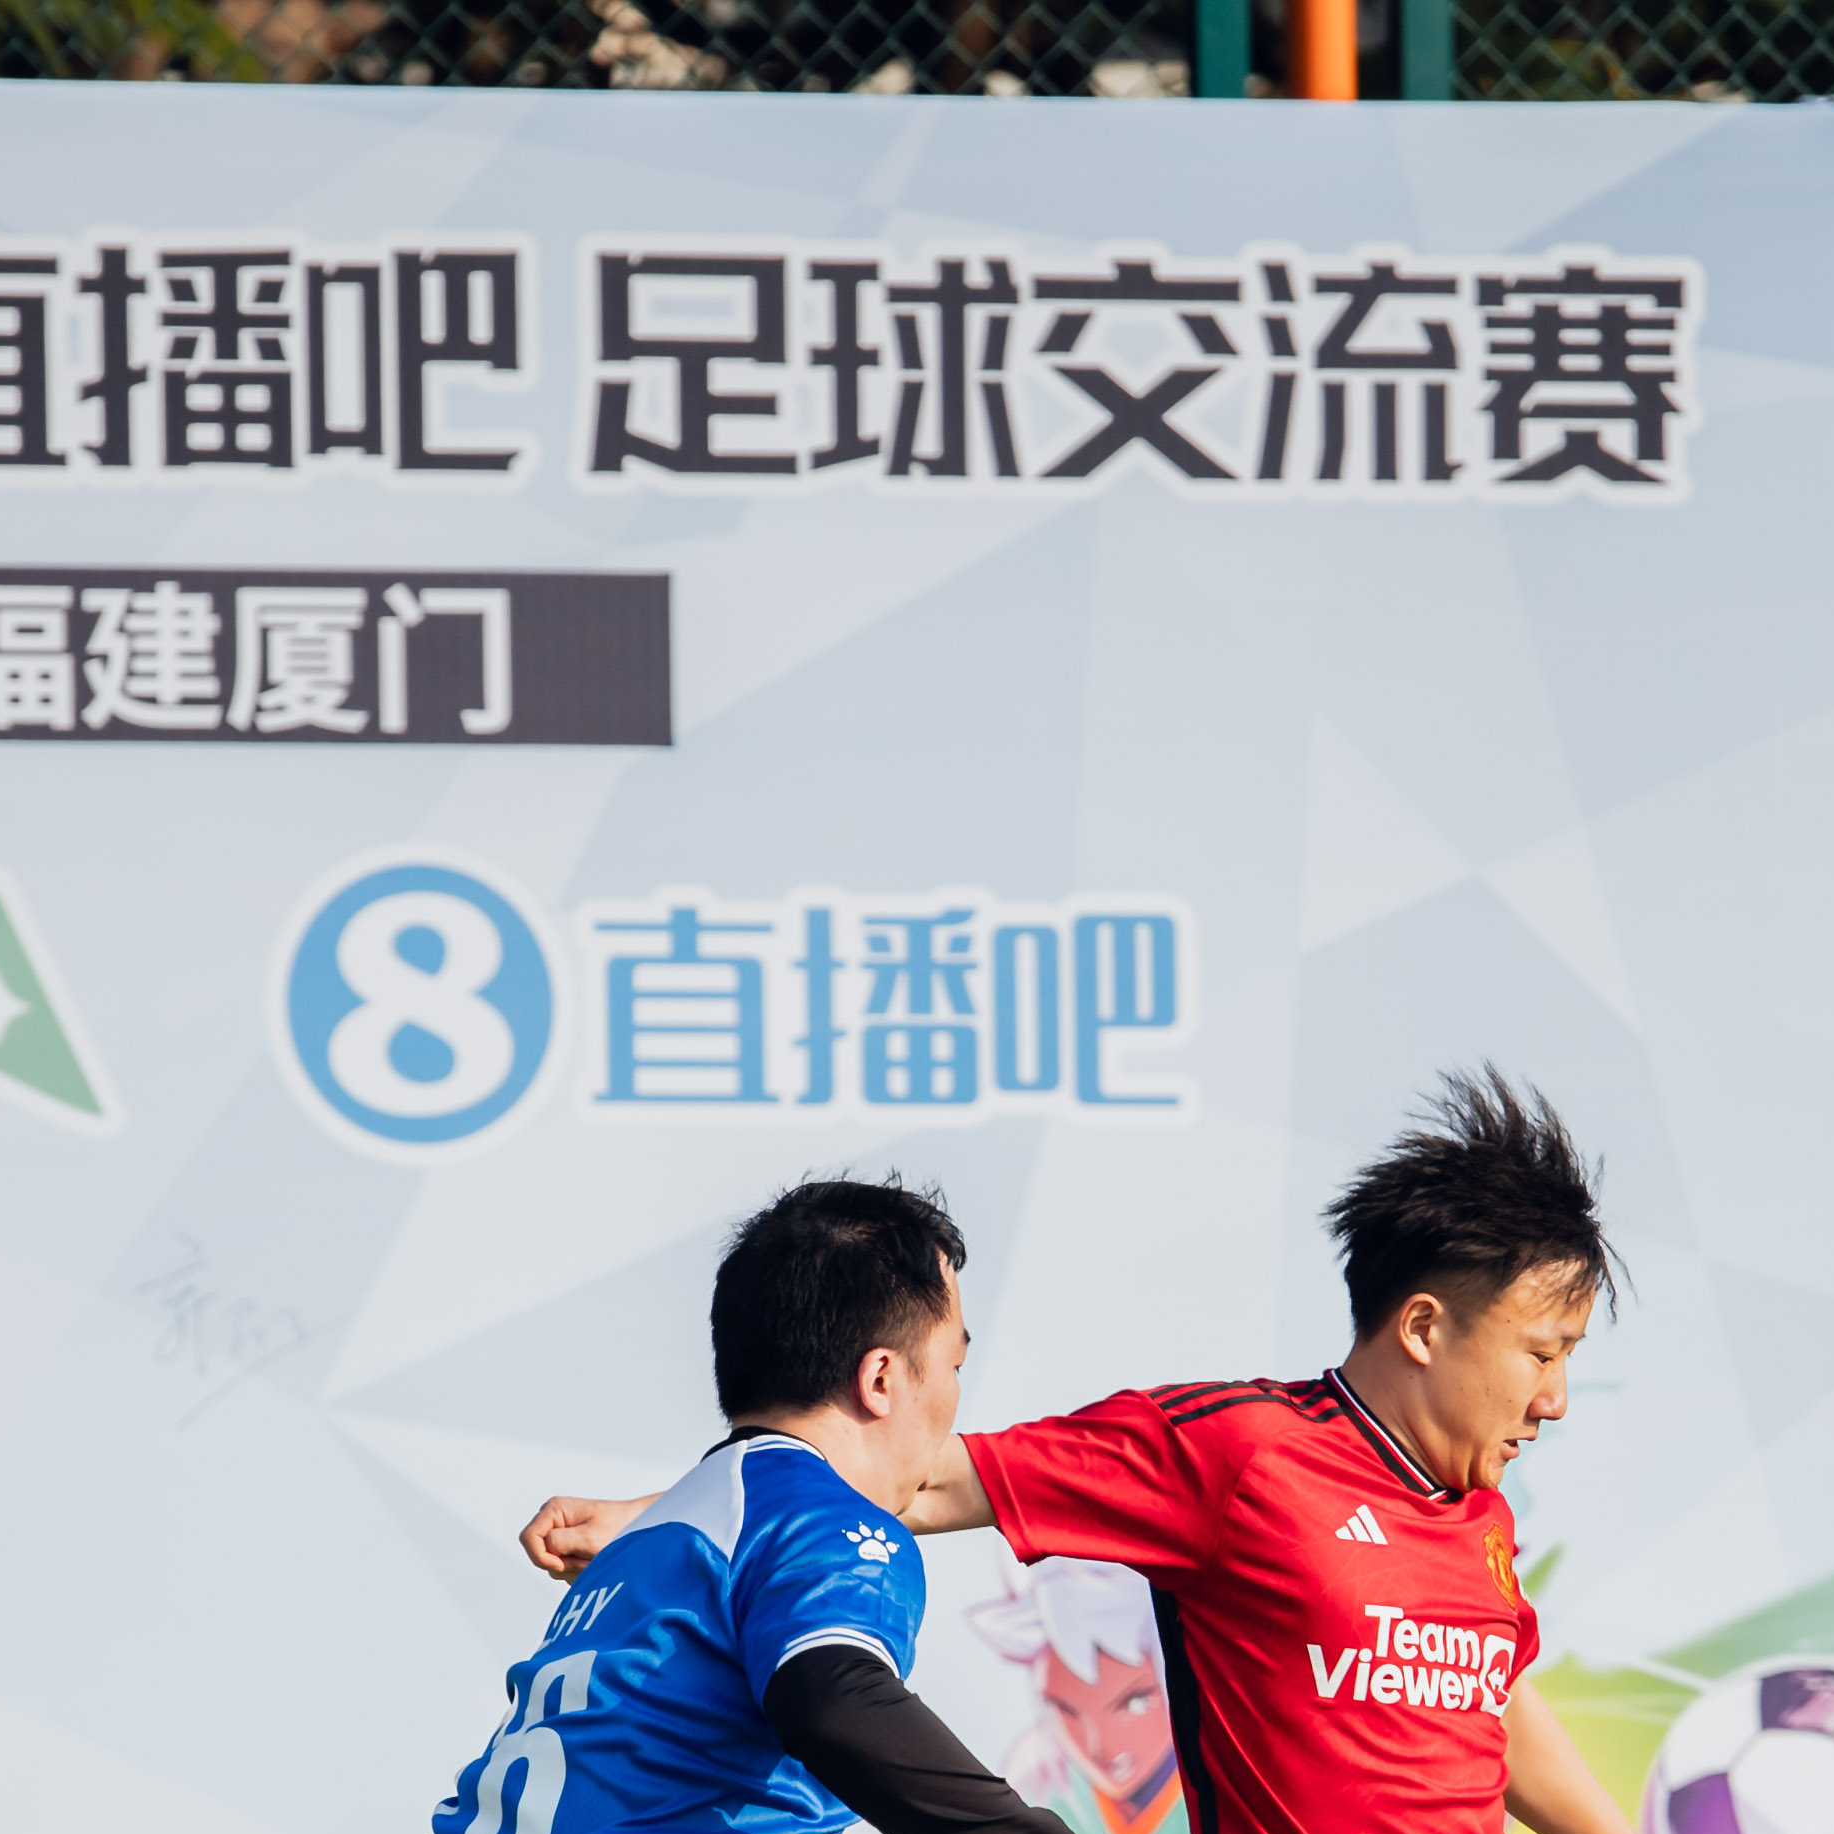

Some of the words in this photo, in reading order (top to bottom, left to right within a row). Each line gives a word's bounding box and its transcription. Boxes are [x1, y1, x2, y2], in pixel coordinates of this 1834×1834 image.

[589, 254, 1686, 484] 足球交流赛
[592, 906, 1183, 1105] 直播吧
[1306, 1643, 1479, 1711] Viewer
[1364, 1604, 1480, 1670] Team
